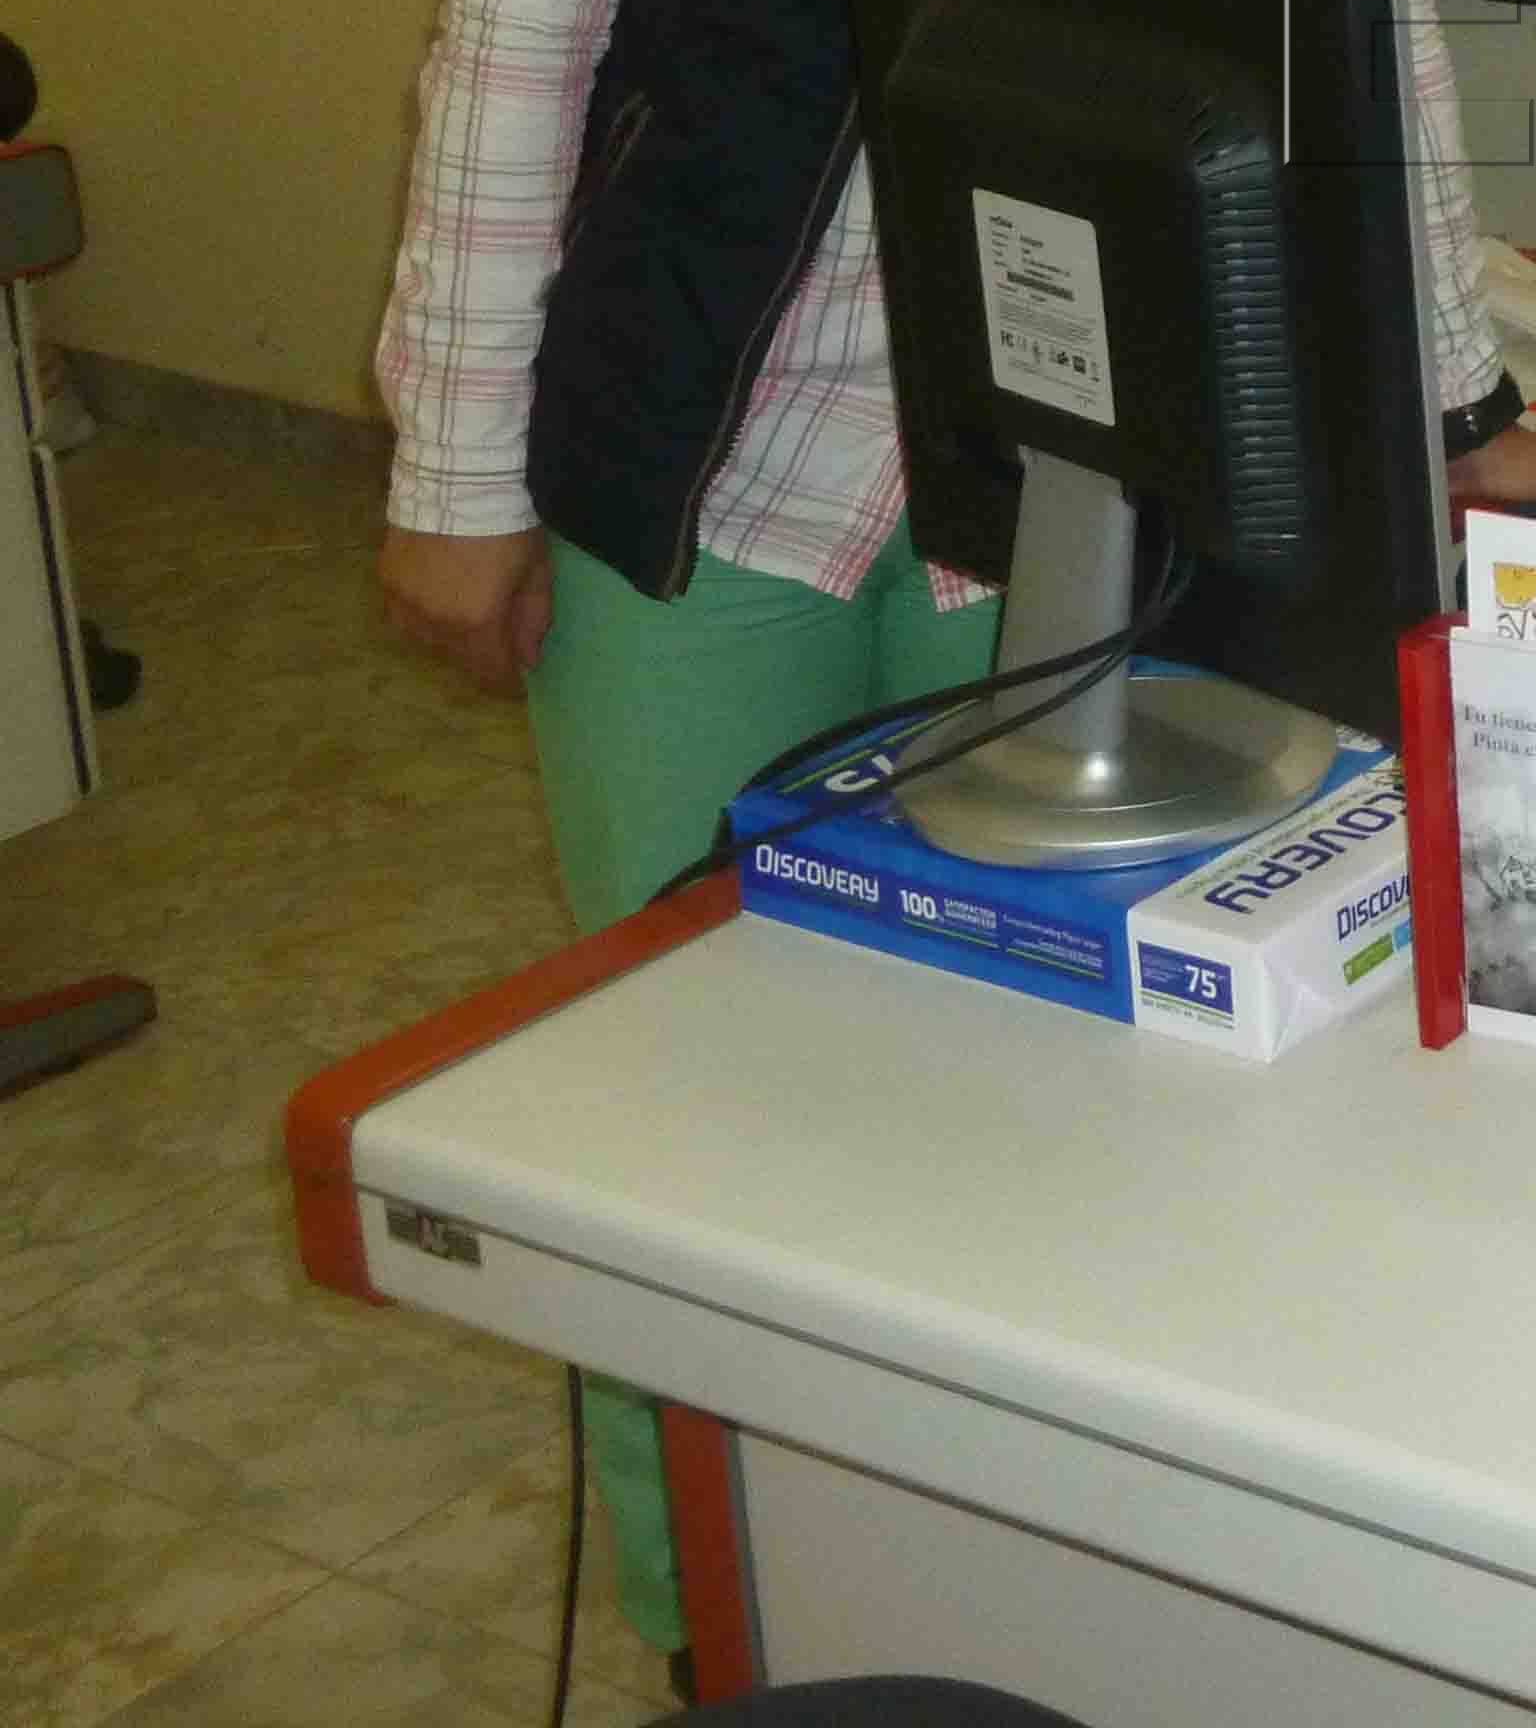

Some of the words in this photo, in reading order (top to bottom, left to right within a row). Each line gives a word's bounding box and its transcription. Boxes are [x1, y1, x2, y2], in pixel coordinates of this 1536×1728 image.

[1473, 731, 1521, 757] Pinta
[754, 843, 880, 904] DISCOVERY
[1336, 873, 1410, 943] DISCOV
[1184, 964, 1217, 999] 75
